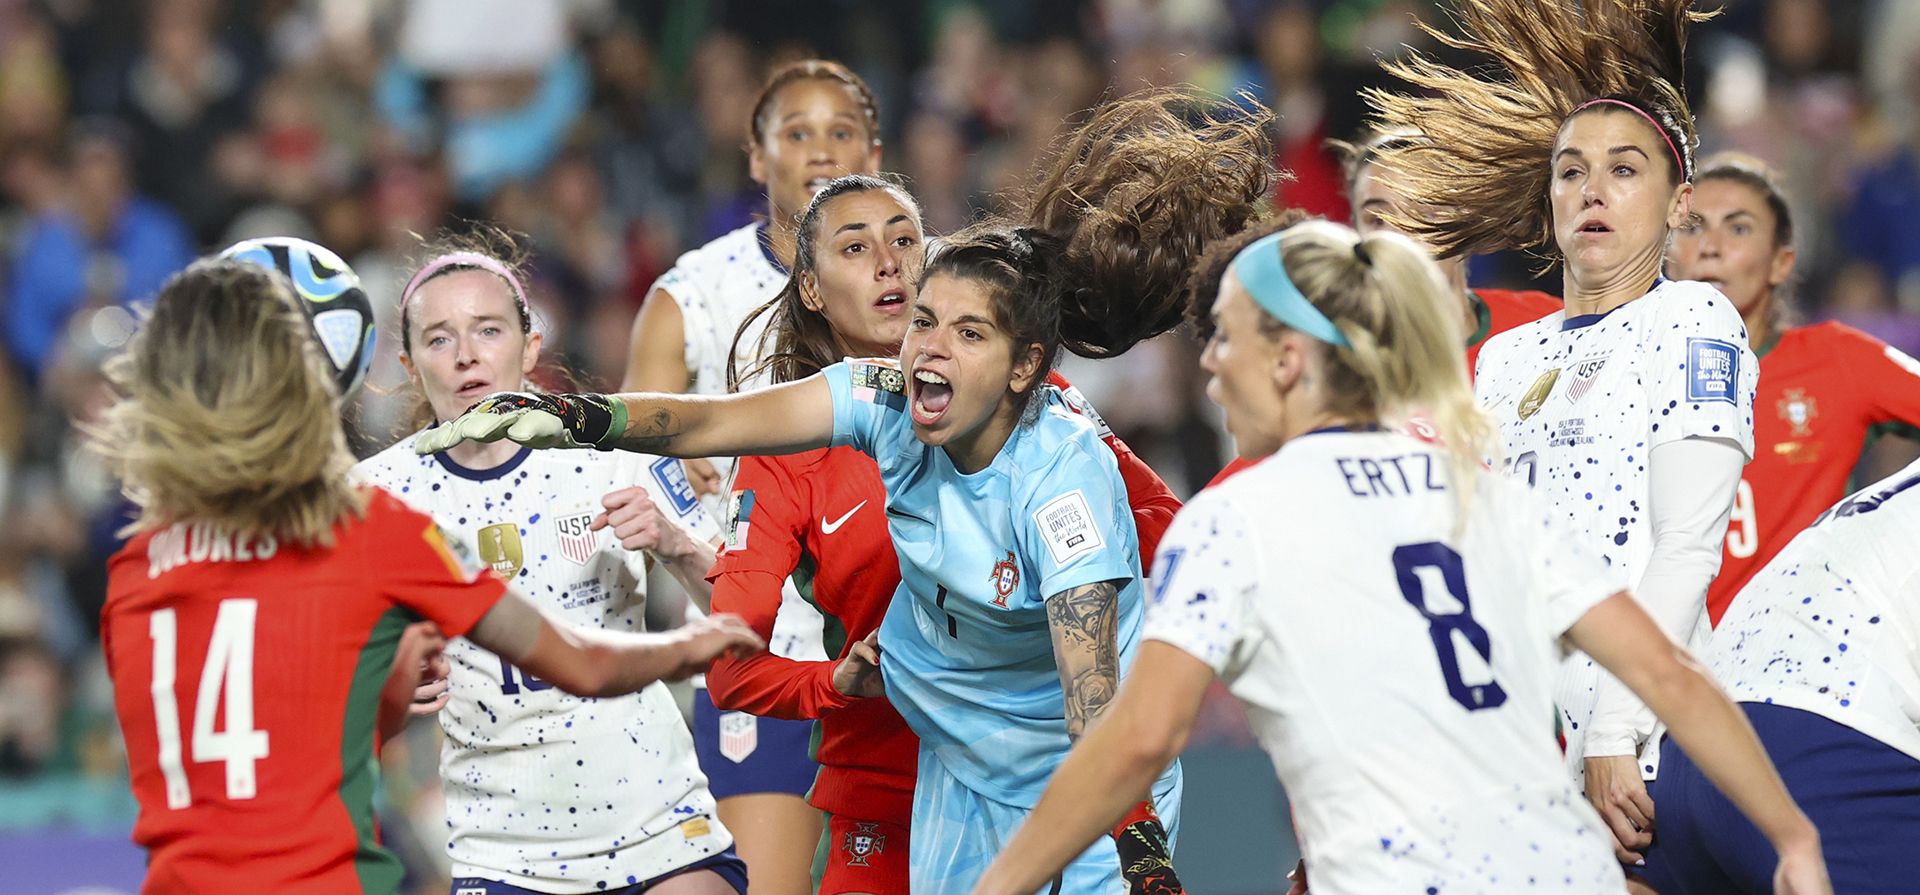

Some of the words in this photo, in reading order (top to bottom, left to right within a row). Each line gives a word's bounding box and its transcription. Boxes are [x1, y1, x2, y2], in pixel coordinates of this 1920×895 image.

[1336, 453, 1446, 496] ERTZ
[1045, 503, 1077, 523] FOOTBALL
[1049, 510, 1082, 533] UNITES
[1392, 541, 1508, 711] 8
[149, 598, 270, 810] 14
